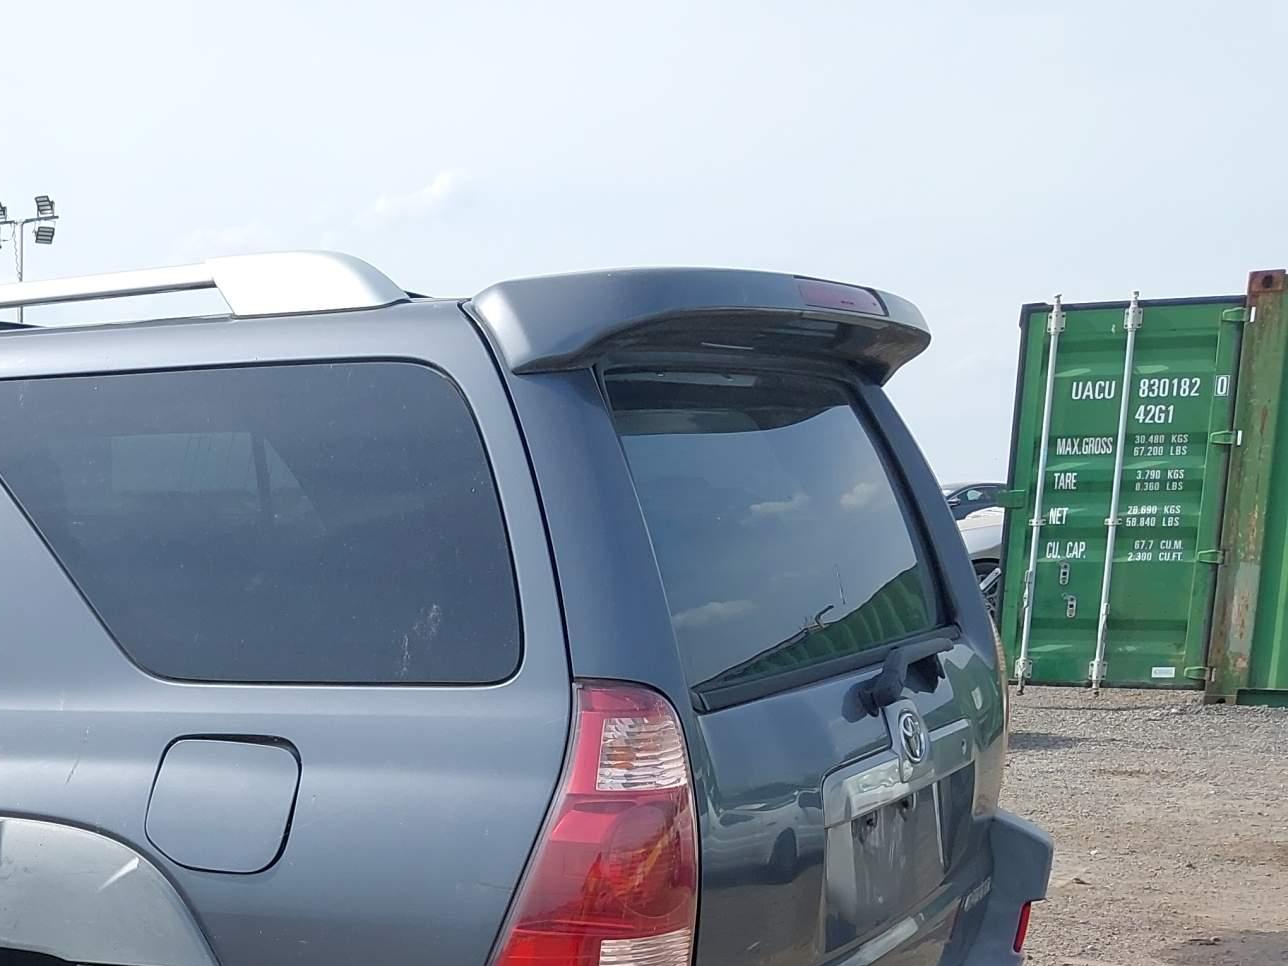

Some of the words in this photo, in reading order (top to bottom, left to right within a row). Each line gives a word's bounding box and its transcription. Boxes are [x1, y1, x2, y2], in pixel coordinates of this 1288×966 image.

[1071, 380, 1116, 400] UACU
[1139, 377, 1201, 398] 830182
[1215, 375, 1229, 396] 0
[1134, 404, 1175, 424] 42G1
[1171, 434, 1189, 443] KGS
[1133, 446, 1164, 456] 67.200
[1170, 446, 1188, 456] LBS
[1053, 472, 1078, 490] TARE
[1136, 469, 1161, 480] 3.790
[1167, 469, 1185, 480] KGS
[1166, 482, 1184, 491] LBS
[1048, 507, 1069, 525] NET
[1163, 505, 1181, 515] KGS
[1162, 517, 1180, 527] LBS
[1046, 542, 1061, 559] CU.
[1065, 541, 1086, 559] CAP.
[1134, 540, 1154, 550] 67.7
